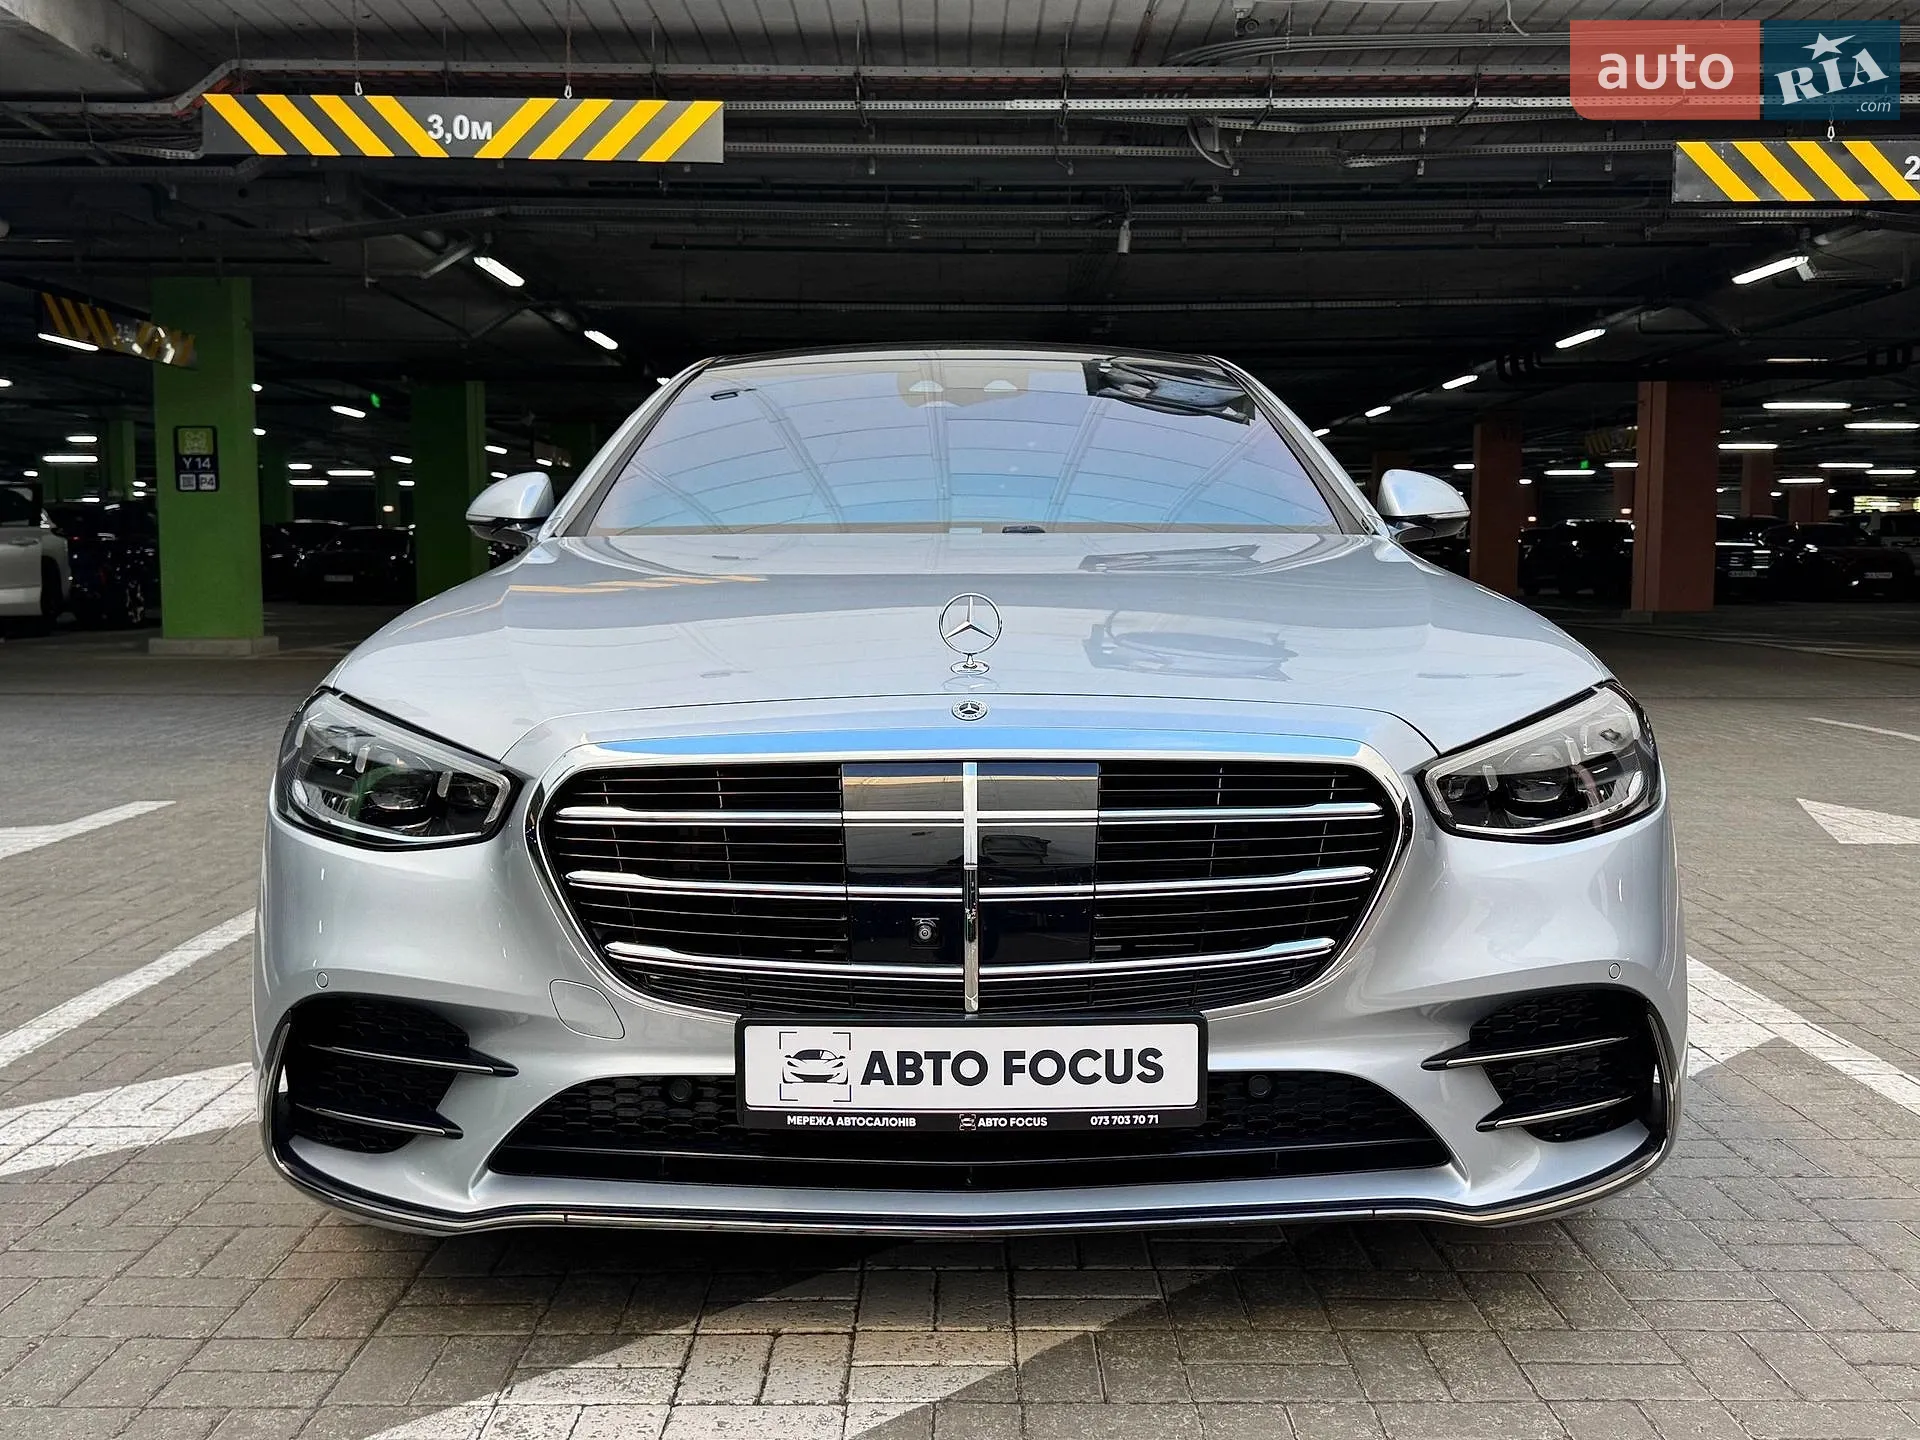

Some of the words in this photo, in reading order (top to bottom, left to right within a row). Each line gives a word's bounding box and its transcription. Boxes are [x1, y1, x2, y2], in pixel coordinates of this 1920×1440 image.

[195, 457, 211, 469] 14
[860, 1050, 988, 1087] АВТО
[1003, 1047, 1164, 1086] FOCUS
[786, 1115, 834, 1127] МЕРЕЖА
[836, 1116, 917, 1128] АВТОСАЛОНІВ
[977, 1117, 1007, 1127] АВТО
[1009, 1117, 1048, 1127] FOCUS
[1090, 1116, 1110, 1126] 073
[1112, 1115, 1131, 1125] 703
[1132, 1115, 1146, 1125] 70
[1148, 1114, 1159, 1125] 71
